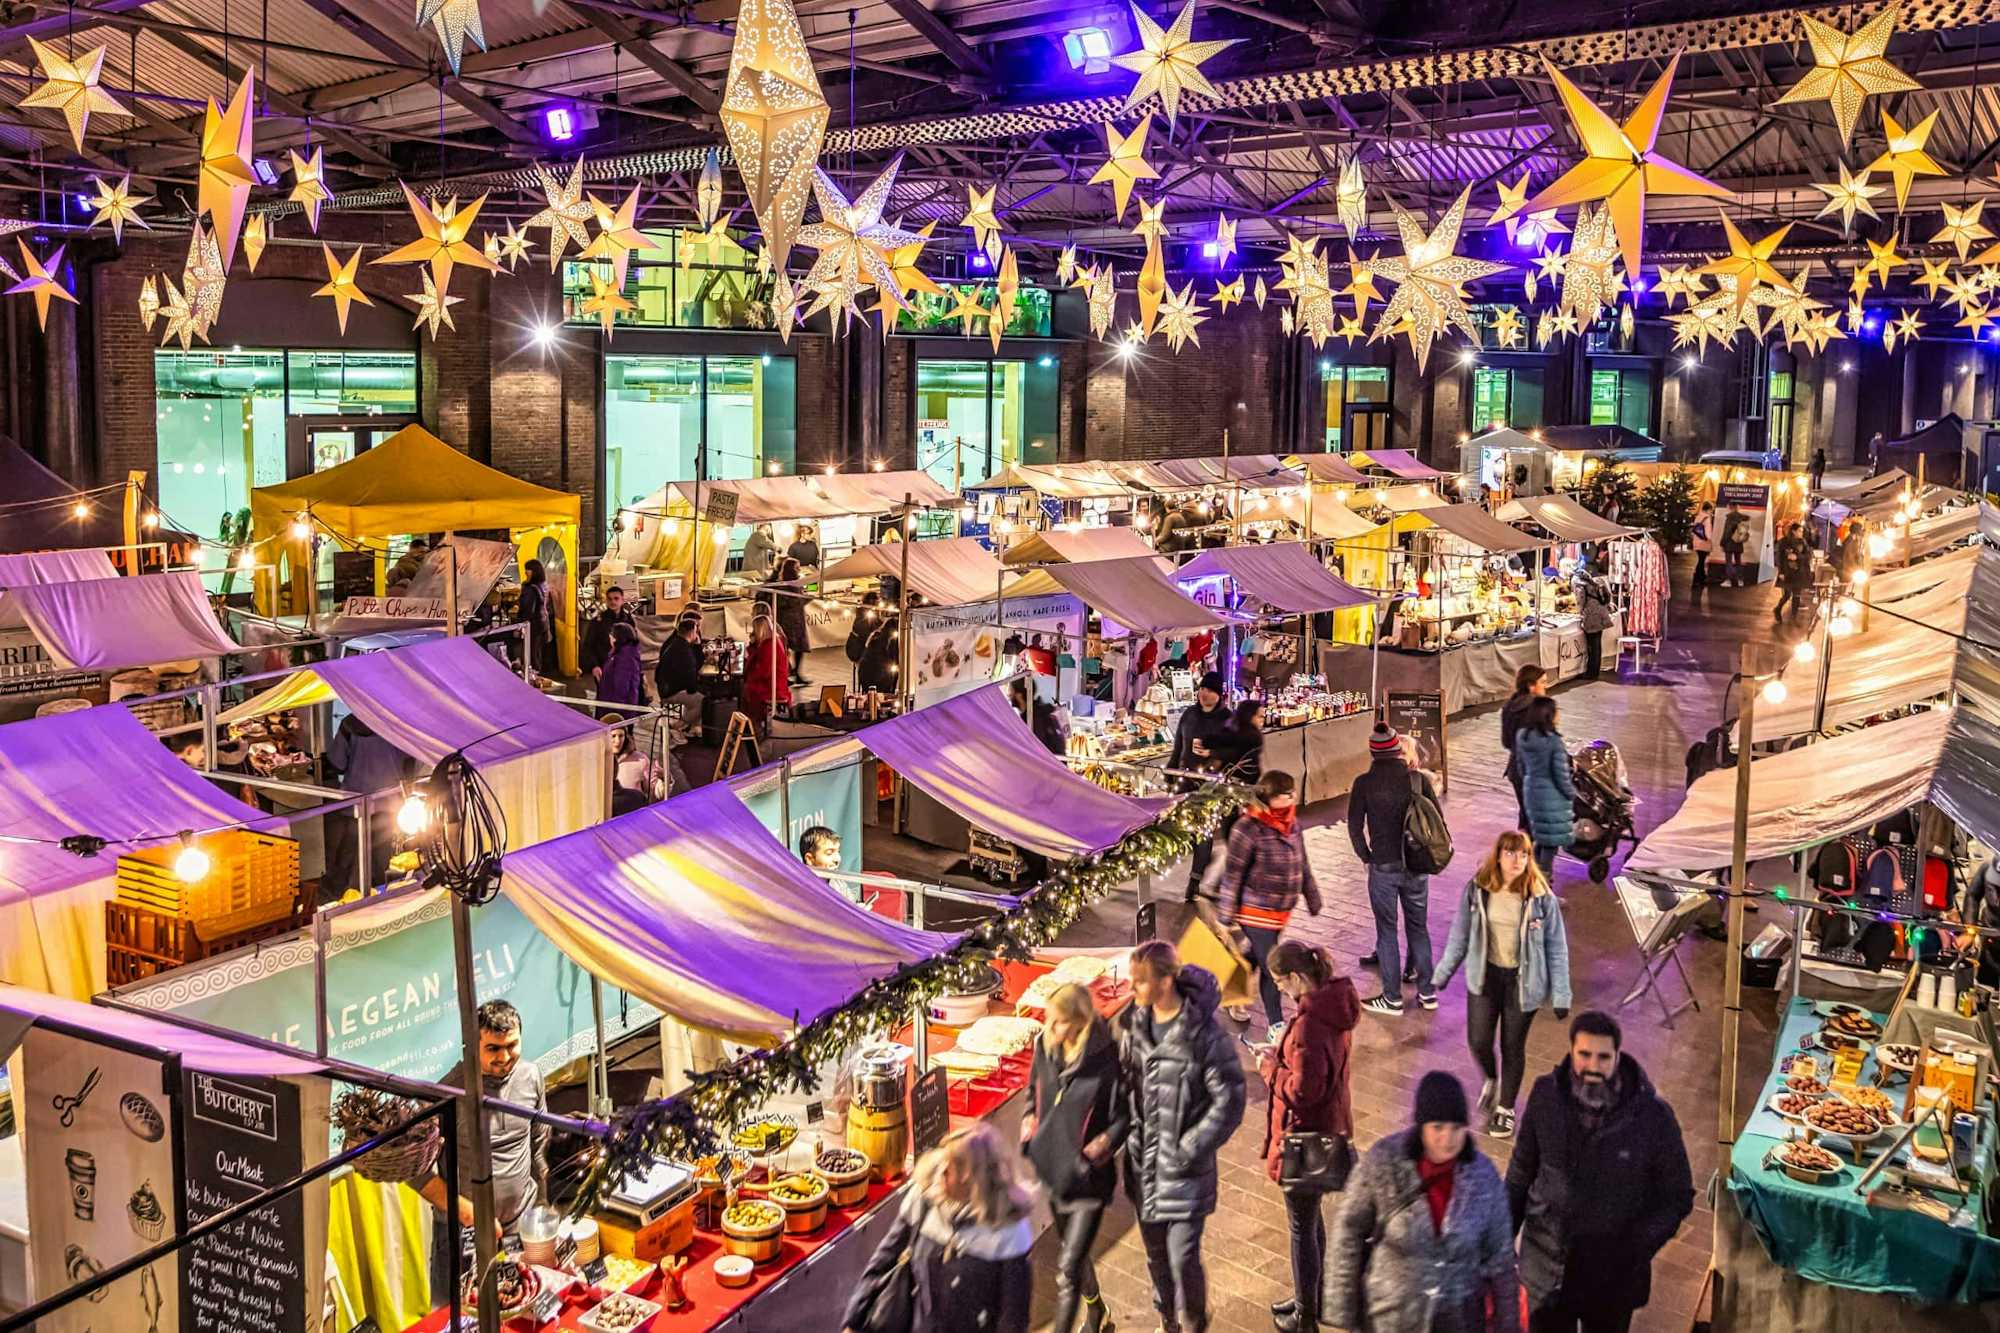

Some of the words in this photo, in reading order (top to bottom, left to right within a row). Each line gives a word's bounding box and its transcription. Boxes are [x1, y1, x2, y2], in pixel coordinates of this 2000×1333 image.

[712, 491, 735, 505] PASTA
[1193, 589, 1216, 606] Gin
[33, 680, 48, 689] best
[49, 675, 100, 687] cheesemakers
[454, 943, 514, 993] ELI
[342, 1035, 368, 1053] FOOD
[396, 1017, 412, 1031] ALL
[197, 1075, 213, 1089] THE
[204, 1089, 265, 1122] BUTCHERY
[216, 1150, 238, 1174] Our
[237, 1156, 264, 1182] Meat
[186, 1179, 201, 1201] We
[235, 1221, 246, 1241] of
[251, 1225, 285, 1252] Native
[191, 1250, 209, 1270] from
[211, 1260, 234, 1277] small
[237, 1263, 250, 1282] UK
[261, 1257, 299, 1280] animals
[188, 1269, 204, 1290] We
[238, 1287, 272, 1319] directly
[275, 1297, 285, 1315] to
[192, 1294, 220, 1313] ensure
[223, 1299, 241, 1324] high
[196, 1308, 214, 1329] fair
